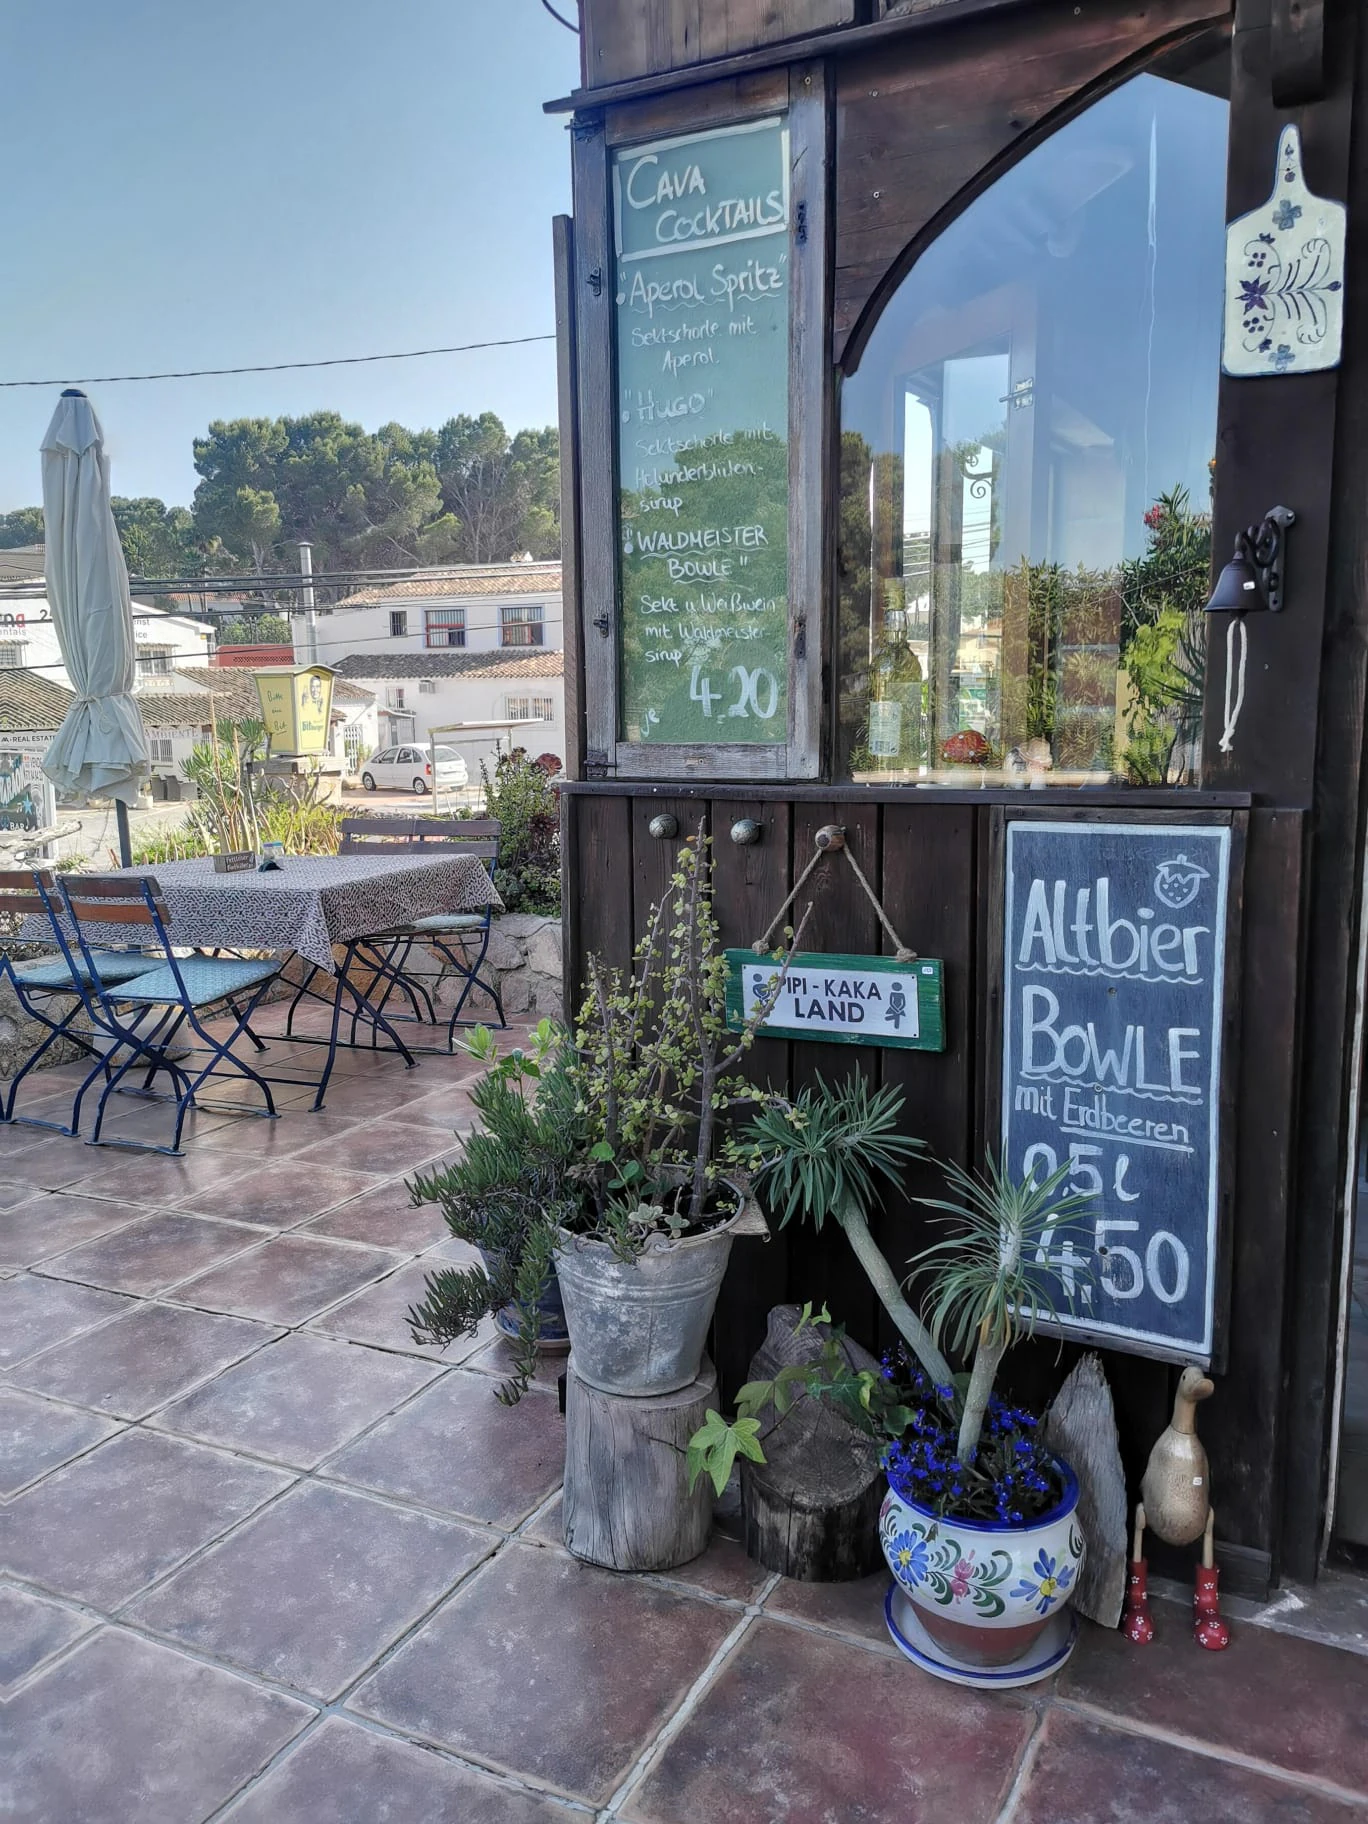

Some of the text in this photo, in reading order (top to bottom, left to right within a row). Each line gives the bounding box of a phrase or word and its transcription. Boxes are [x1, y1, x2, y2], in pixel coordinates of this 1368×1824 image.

[627, 155, 706, 209] CAVA
[656, 190, 784, 243] COCKTAILS
[728, 315, 757, 336] mit
[640, 496, 683, 517] sirup
[640, 594, 679, 614] Sekt
[645, 623, 673, 639] mit
[645, 648, 683, 666] sirup
[1018, 877, 1211, 976] Altbier
[824, 978, 882, 1001] KAKA
[794, 997, 865, 1023] LAND
[1022, 984, 1203, 1095] BOWLE
[1014, 1085, 1190, 1144] mit Erdbeeren
